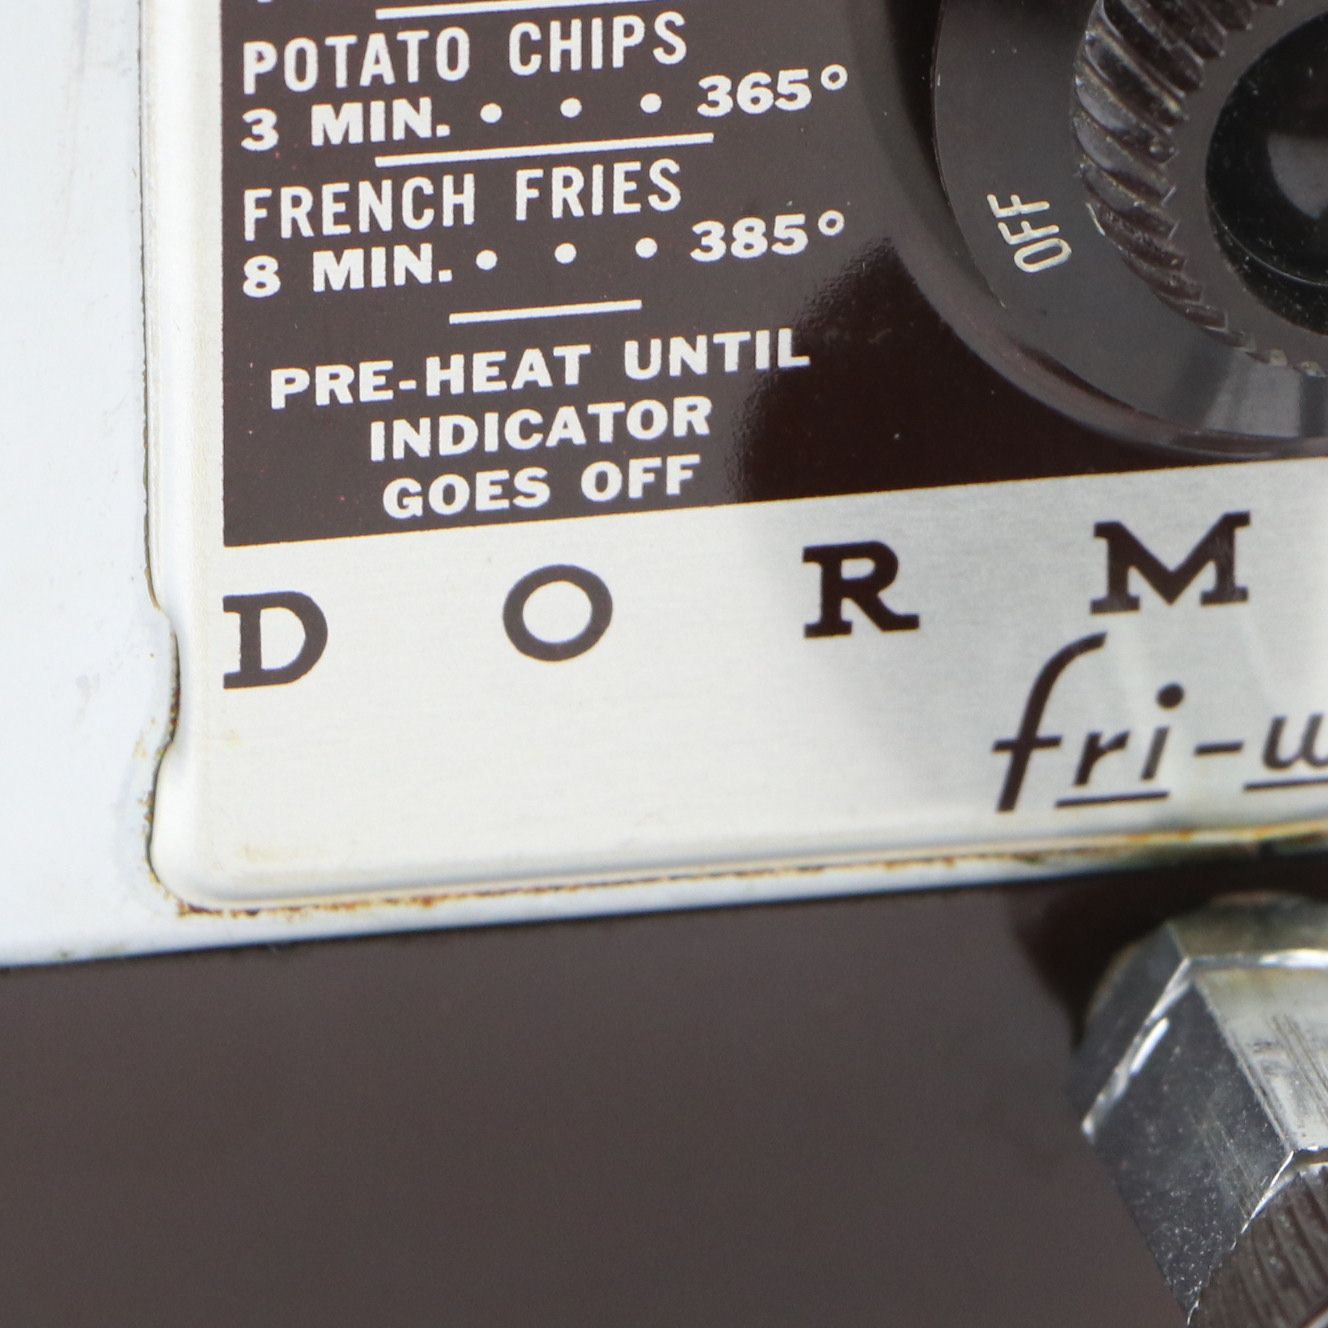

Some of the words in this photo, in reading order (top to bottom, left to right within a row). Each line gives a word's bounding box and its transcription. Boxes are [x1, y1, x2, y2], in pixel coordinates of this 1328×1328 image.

[243, 26, 470, 95] POTATO
[508, 11, 687, 76] CHIPS
[241, 108, 279, 151] 3
[311, 96, 451, 147] MIN.
[243, 173, 476, 242] FRENCH
[515, 158, 682, 221] FRIES
[985, 191, 1073, 275] OFF
[242, 255, 281, 298] 8
[312, 242, 453, 293] MIN.
[270, 344, 592, 410] PRE-HEAT
[623, 327, 810, 381] UNTIL
[370, 395, 713, 462] INDICATOR
[382, 466, 551, 520] GOES
[580, 454, 701, 502] OFF
